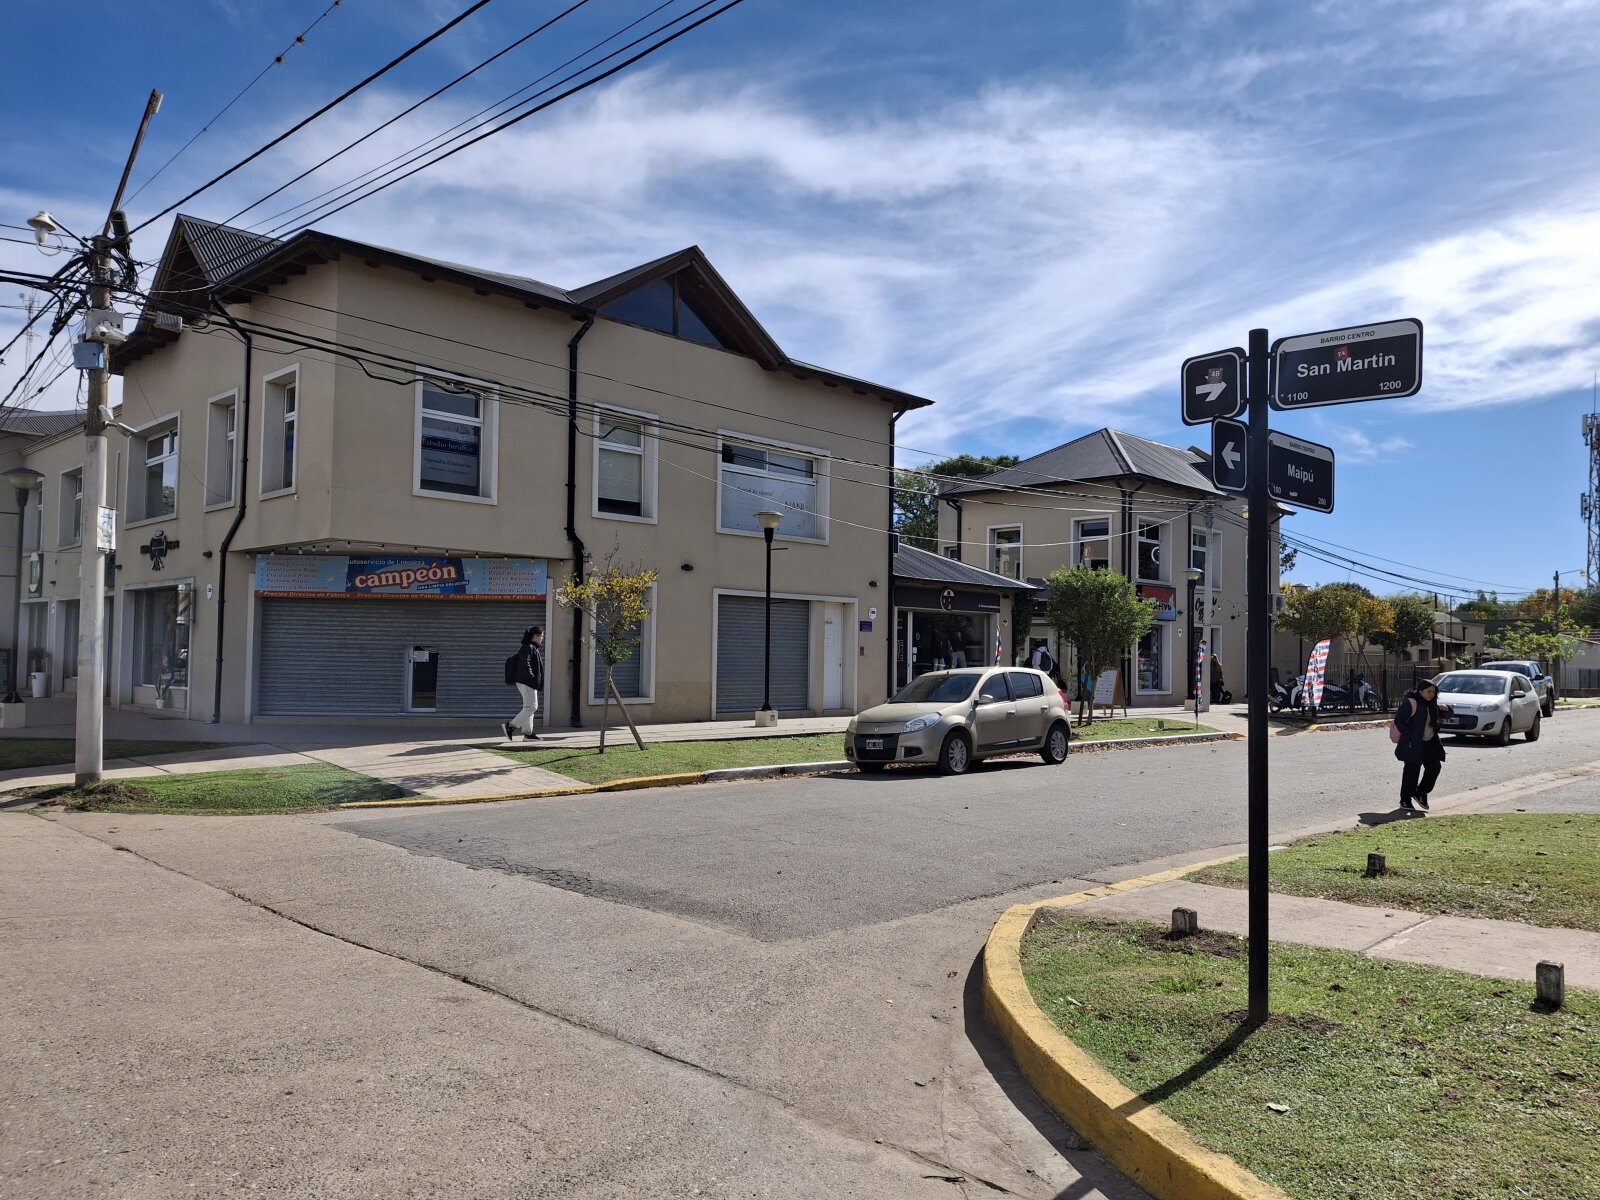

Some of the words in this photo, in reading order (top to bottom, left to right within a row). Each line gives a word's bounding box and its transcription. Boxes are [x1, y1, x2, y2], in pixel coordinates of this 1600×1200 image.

[1320, 335, 1345, 344] BARRIO
[1347, 330, 1375, 340] CENTRO
[1296, 363, 1330, 378] San
[1378, 380, 1402, 391] 1200
[1287, 391, 1309, 402] 1100
[422, 438, 447, 448] Estudio
[1289, 441, 1302, 450] BARRIO
[1302, 445, 1316, 455] CENTRO
[1287, 463, 1314, 484] Maipú
[1272, 485, 1282, 494] 100
[1317, 497, 1327, 506] 200
[396, 559, 425, 567] Limpieza
[355, 562, 457, 587] campeón
